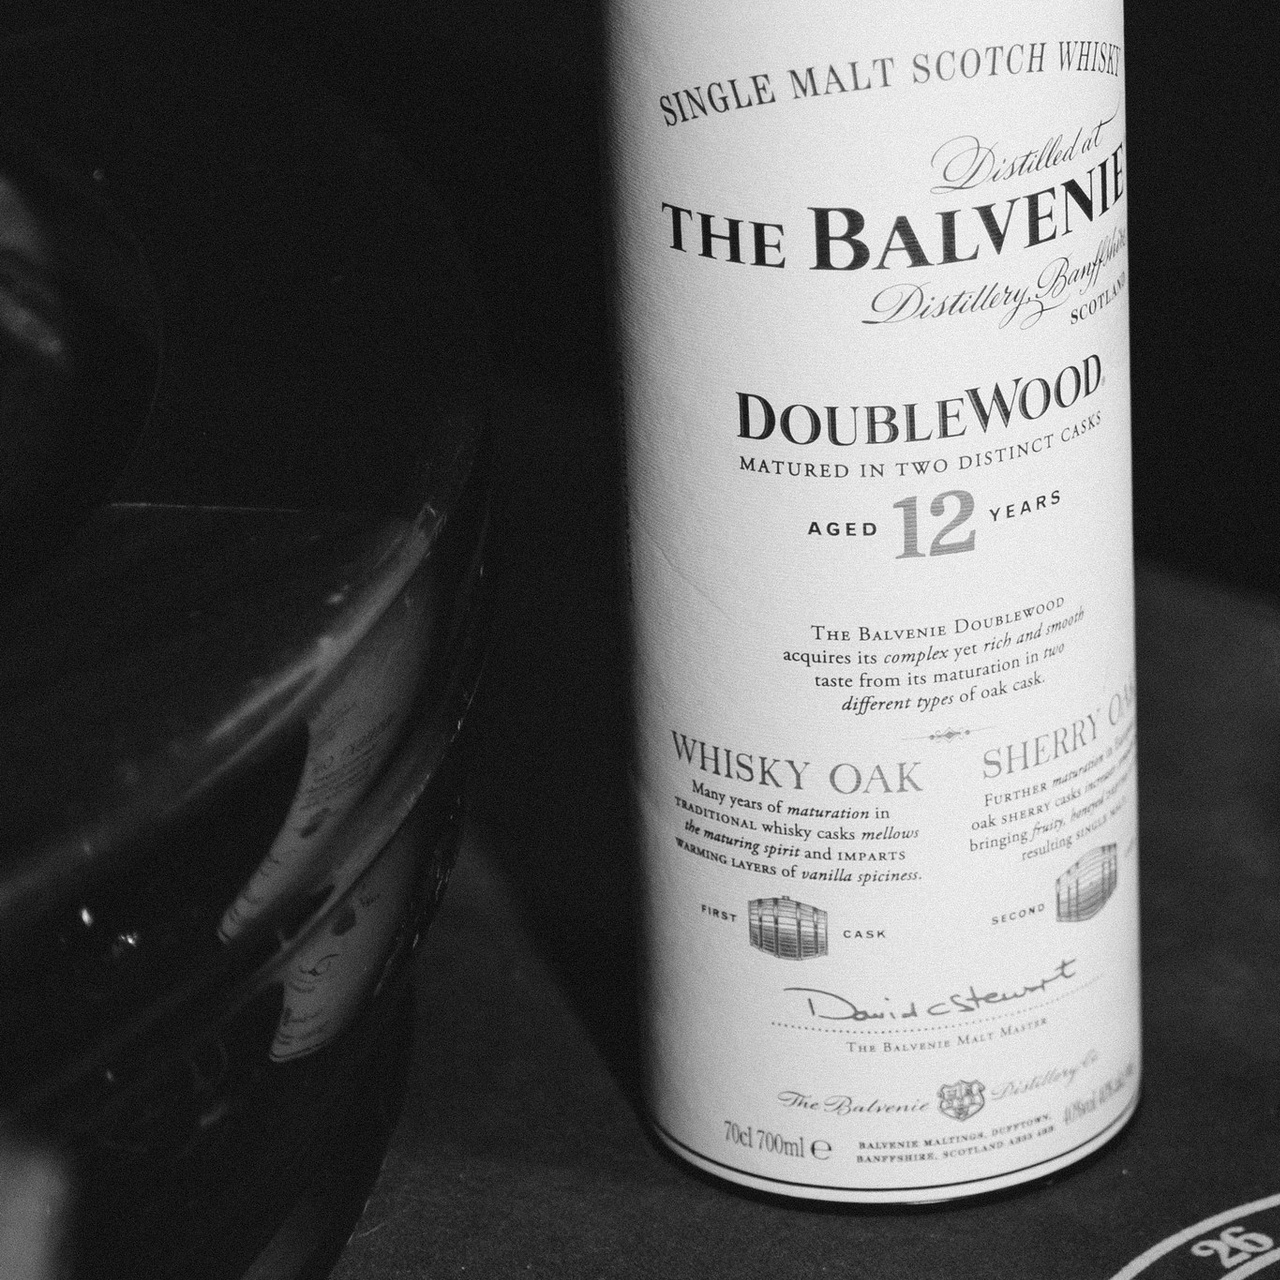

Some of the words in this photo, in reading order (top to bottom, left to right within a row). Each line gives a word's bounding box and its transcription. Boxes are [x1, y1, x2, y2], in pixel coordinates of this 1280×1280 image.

[660, 74, 776, 127] SINGLE
[787, 57, 895, 100] MALT
[912, 43, 1047, 85] SCOTCH
[1058, 40, 1121, 77] WHISKY
[930, 127, 1084, 195] Distilled
[1081, 103, 1119, 155] at
[661, 202, 786, 268] THE
[807, 142, 1123, 272] BALVENIE
[735, 354, 1102, 446] DOUBLEWOOD
[740, 456, 849, 478] MATURED
[860, 463, 885, 478] IN
[896, 458, 948, 477] TWO
[959, 434, 1054, 471] DISTINCT
[1060, 411, 1102, 443] CASKS
[808, 522, 878, 536] AGED
[893, 489, 976, 559] 12
[989, 490, 1061, 522] YEARS
[783, 648, 851, 673] acquires
[858, 650, 877, 665] its
[884, 646, 949, 667] complex
[953, 643, 978, 663] yet
[983, 634, 1012, 652] rich
[1017, 624, 1042, 647] and
[1045, 607, 1085, 637] smooth
[811, 625, 850, 642] THE
[859, 624, 946, 642] BALVENIE
[815, 674, 853, 687] taste
[859, 672, 901, 687] from
[908, 669, 927, 685] its
[933, 657, 1020, 684] maturation
[1025, 649, 1039, 666] in
[1044, 642, 1065, 660] two
[842, 694, 911, 716] different
[916, 693, 954, 713] types
[959, 687, 977, 704] of
[981, 679, 1008, 699] oak
[1012, 671, 1046, 692] cask.
[671, 730, 810, 791] WHISKY
[829, 761, 923, 795] OAK
[982, 709, 1101, 780] SHERRY
[692, 779, 726, 805] Many
[730, 793, 762, 812] years
[767, 801, 784, 814] of
[787, 805, 869, 820] maturation
[875, 807, 890, 819] in
[971, 813, 996, 832] oak
[1001, 801, 1052, 825] SHERRY
[1054, 786, 1082, 808] casks
[984, 782, 1047, 808] FURTHER
[675, 796, 757, 831] TRADITIONAL
[762, 820, 812, 842] whisky
[817, 827, 855, 840] casks
[861, 826, 919, 841] mellows
[685, 819, 700, 835] the
[704, 829, 760, 856] maturing
[764, 841, 801, 859] spirit
[805, 847, 832, 861] and
[838, 851, 906, 861] IMPARTS
[969, 828, 1028, 853] bringing
[675, 836, 727, 865] WARMING
[731, 857, 776, 876] LAYERS
[782, 865, 797, 878] of
[802, 868, 852, 882] vanilla
[857, 869, 922, 887] spiciness.
[1021, 836, 1073, 862] resulting
[701, 904, 737, 922] FIRST
[843, 930, 886, 939] CASK
[991, 903, 1046, 926] SECOND
[784, 987, 917, 1021] David
[846, 1042, 876, 1053] THE
[883, 1039, 950, 1053] BALVENIE
[957, 1032, 994, 1046] MALT
[777, 1091, 819, 1110] The
[823, 1095, 929, 1116] Balvenie
[724, 1120, 752, 1149] 70cl
[756, 1129, 804, 1158] 700ml
[858, 1139, 918, 1150] BALVENIE
[1191, 1226, 1274, 1268] 26
